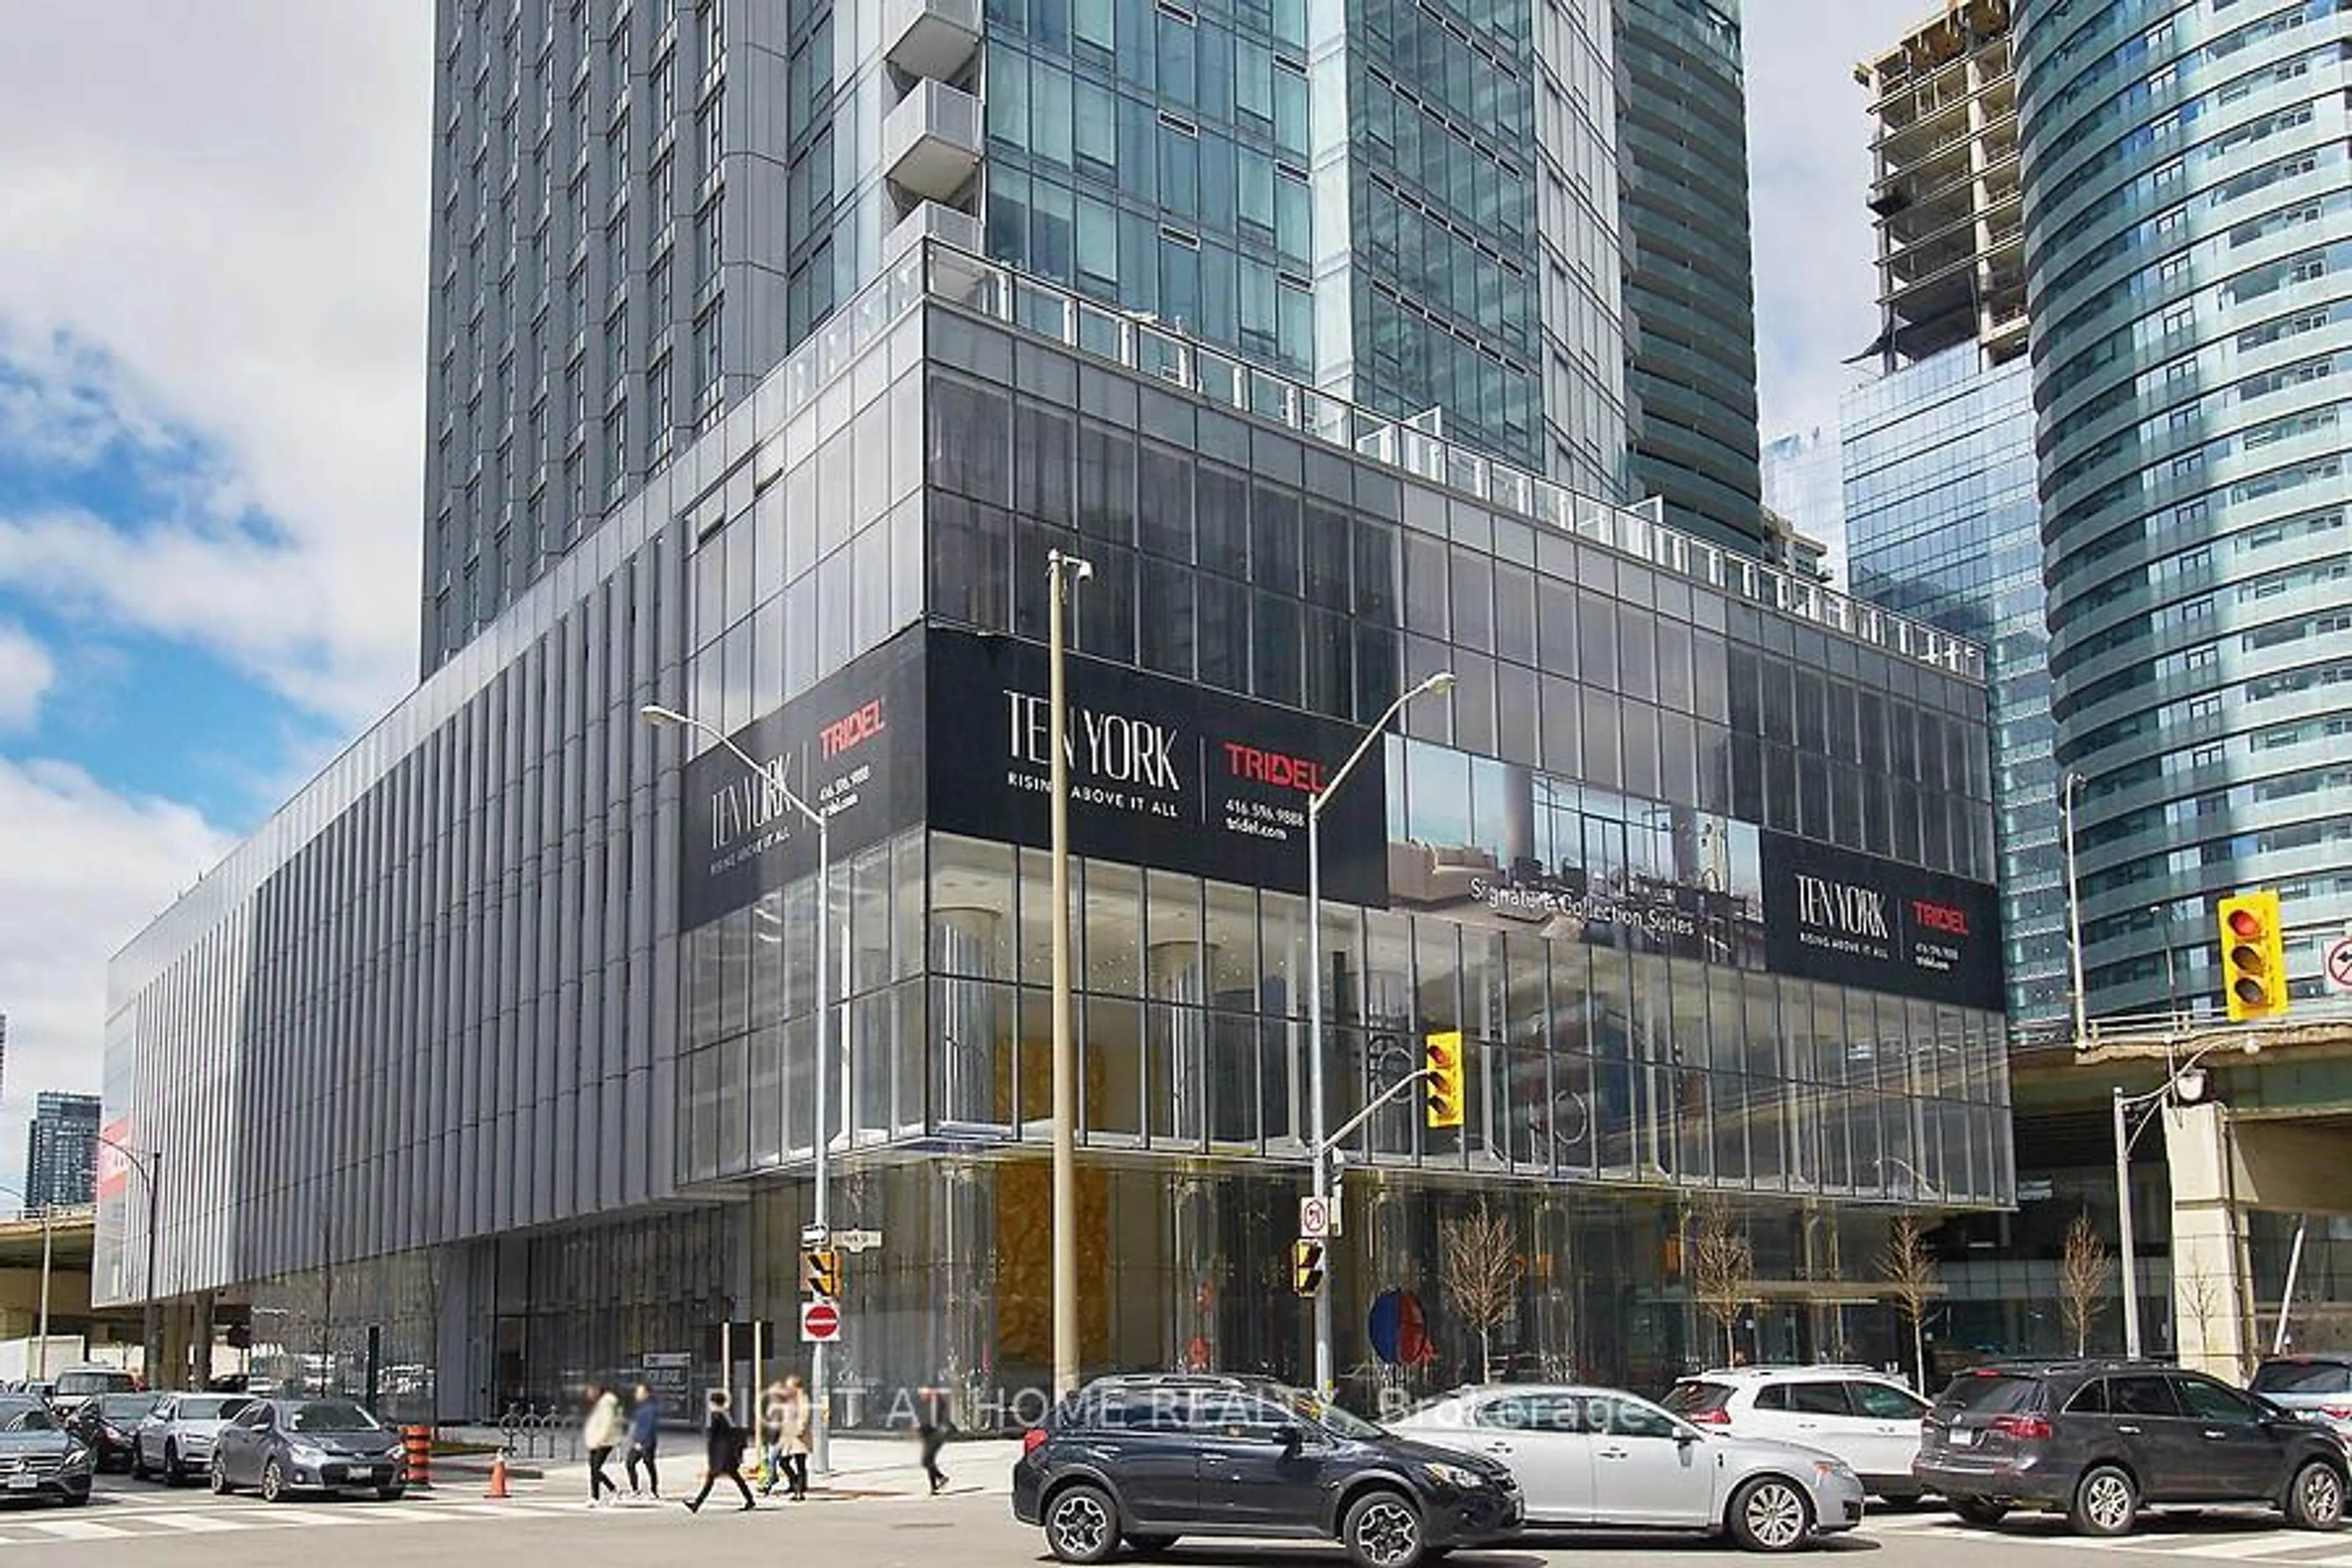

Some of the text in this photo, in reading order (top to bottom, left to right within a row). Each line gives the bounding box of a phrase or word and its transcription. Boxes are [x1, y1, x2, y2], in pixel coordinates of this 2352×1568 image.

[820, 699, 886, 761] TRIDEL
[1083, 708, 1179, 791] YORK
[1224, 742, 1326, 794] TRIDEL
[1071, 785, 1125, 809] ABOVE
[1131, 797, 1144, 811] IT
[1152, 802, 1178, 817] ALL
[1471, 877, 1695, 935] Signature Collection Suites
[1795, 873, 1888, 939] TEN YORK
[1912, 901, 1969, 936] TRIDEL
